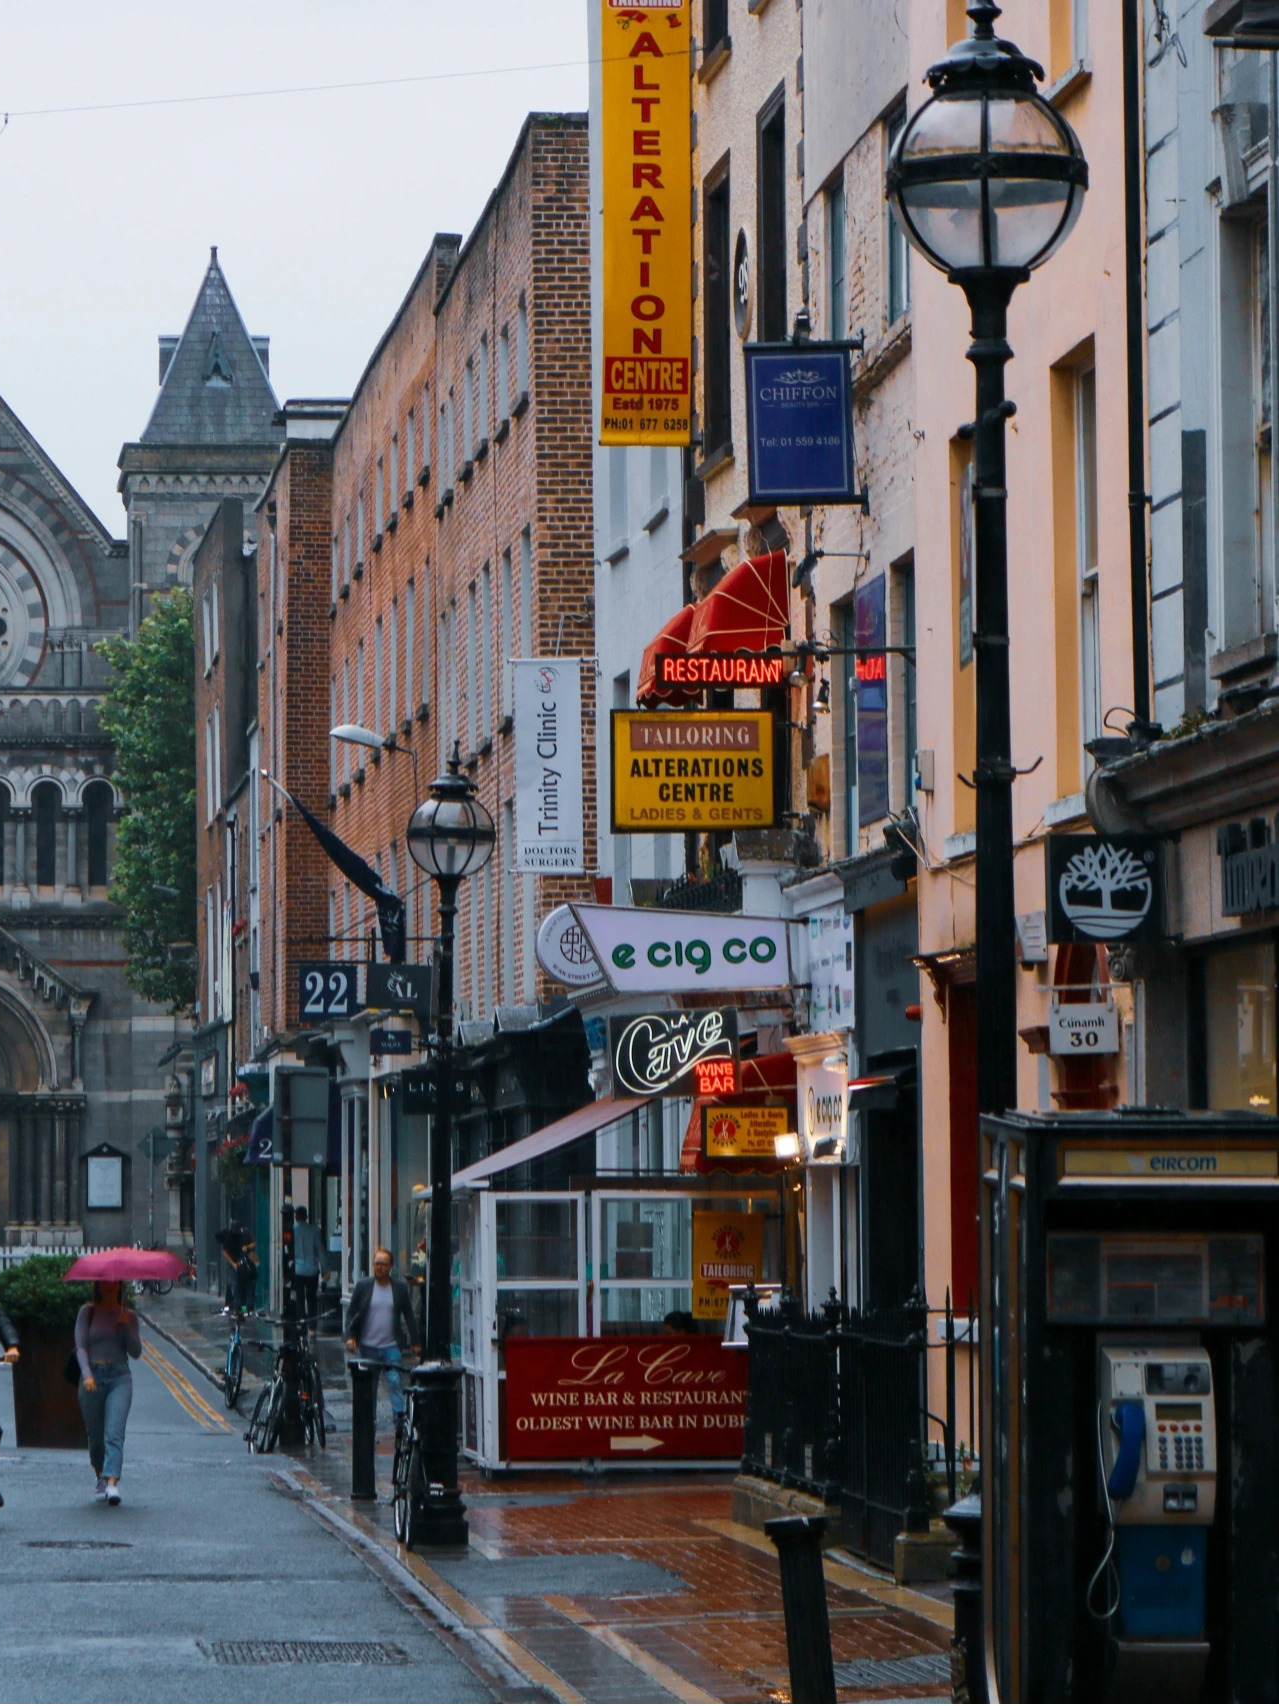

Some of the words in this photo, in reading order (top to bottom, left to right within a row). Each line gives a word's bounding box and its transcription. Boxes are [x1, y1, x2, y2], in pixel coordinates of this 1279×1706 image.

[629, 31, 665, 355] ALTERATION
[610, 360, 684, 391] CENTRE
[760, 386, 837, 401] CHIFFON
[612, 397, 644, 411] Estd
[648, 397, 680, 411] 1975
[604, 417, 633, 430] PH:01
[640, 418, 658, 430] 677
[664, 418, 689, 430] 6258
[760, 437, 778, 448] Tel:
[780, 437, 792, 447] 01
[796, 436, 814, 447] 559
[816, 435, 841, 446] 4186
[664, 658, 782, 683] RESTAURANT
[536, 702, 558, 760] Clinic
[640, 726, 750, 747] TAILORING
[630, 758, 765, 778] ALTERATIONS
[658, 782, 735, 802] CENTRE
[538, 767, 562, 836] Trinity
[630, 807, 686, 821] LADIES
[692, 807, 702, 821] &
[709, 807, 764, 821] GENTS
[524, 846, 578, 855] DOCTORS
[524, 858, 576, 867] SURGERY
[612, 943, 636, 969] e
[647, 938, 712, 974] cig
[722, 936, 777, 963] co
[304, 970, 349, 1014] 22
[670, 1015, 690, 1030] LA
[1070, 1031, 1099, 1047] 30
[616, 1011, 723, 1094] Cave
[696, 1062, 734, 1077] WINE
[409, 1082, 464, 1093] LINS
[699, 1077, 735, 1094] BAR
[1149, 1155, 1218, 1172] eircom
[702, 1263, 754, 1278] TAILORING
[558, 1345, 629, 1386] La
[638, 1345, 726, 1385] Cave
[530, 1392, 580, 1407] WINE
[583, 1392, 618, 1406] BAR
[622, 1392, 636, 1406] &
[516, 1416, 583, 1431] OLDEST
[585, 1416, 635, 1430] WINE
[639, 1415, 674, 1430] BAR
[677, 1415, 698, 1429] IN
